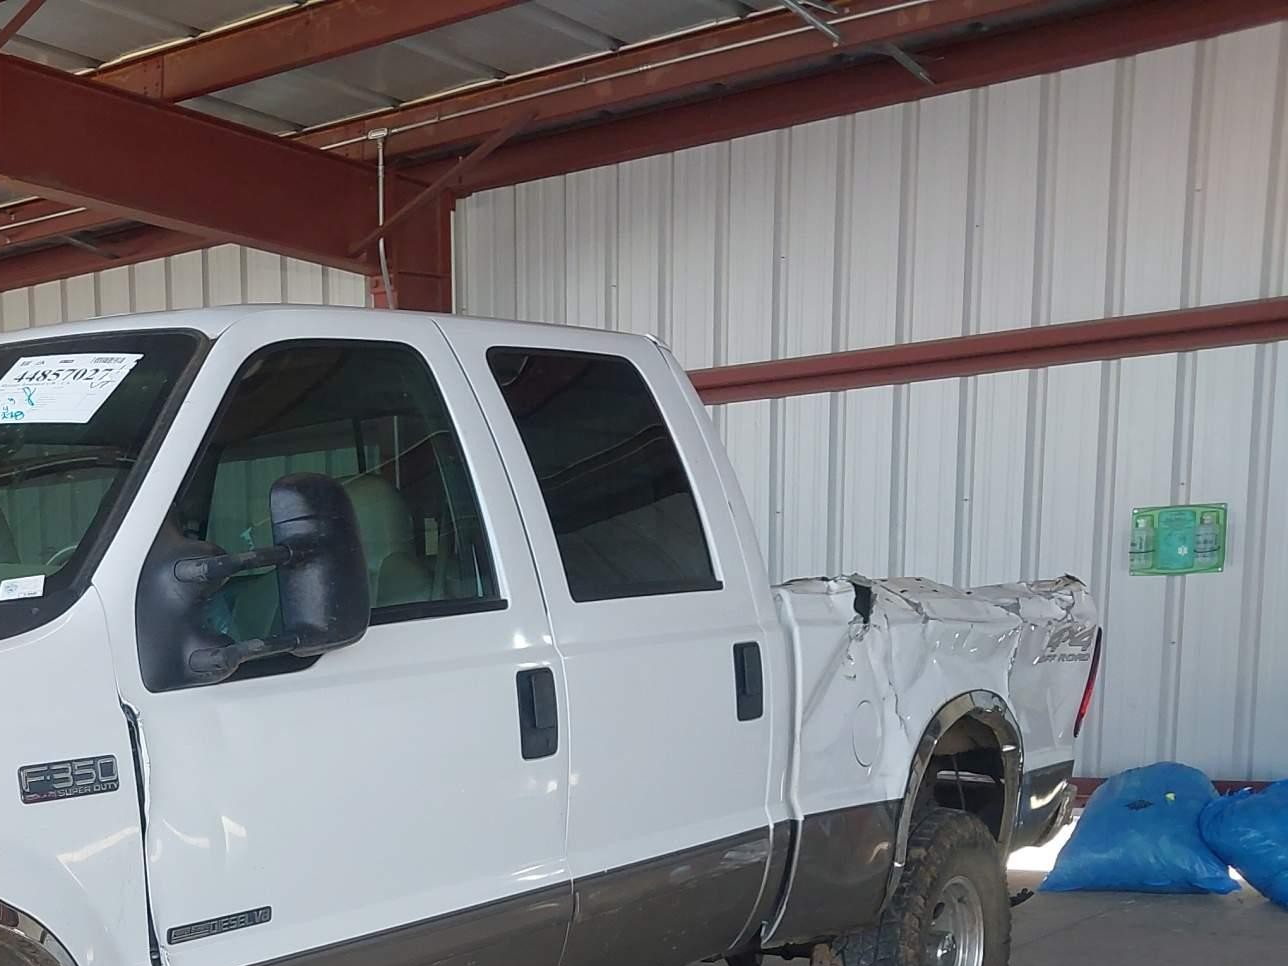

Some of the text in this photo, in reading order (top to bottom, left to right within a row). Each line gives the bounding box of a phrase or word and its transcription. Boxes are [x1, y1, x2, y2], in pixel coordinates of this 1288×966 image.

[14, 367, 114, 383] 44857027
[55, 785, 91, 798] SUPER
[93, 781, 119, 793] DUTY
[210, 911, 255, 934] DIESEL
[254, 907, 271, 924] V8
